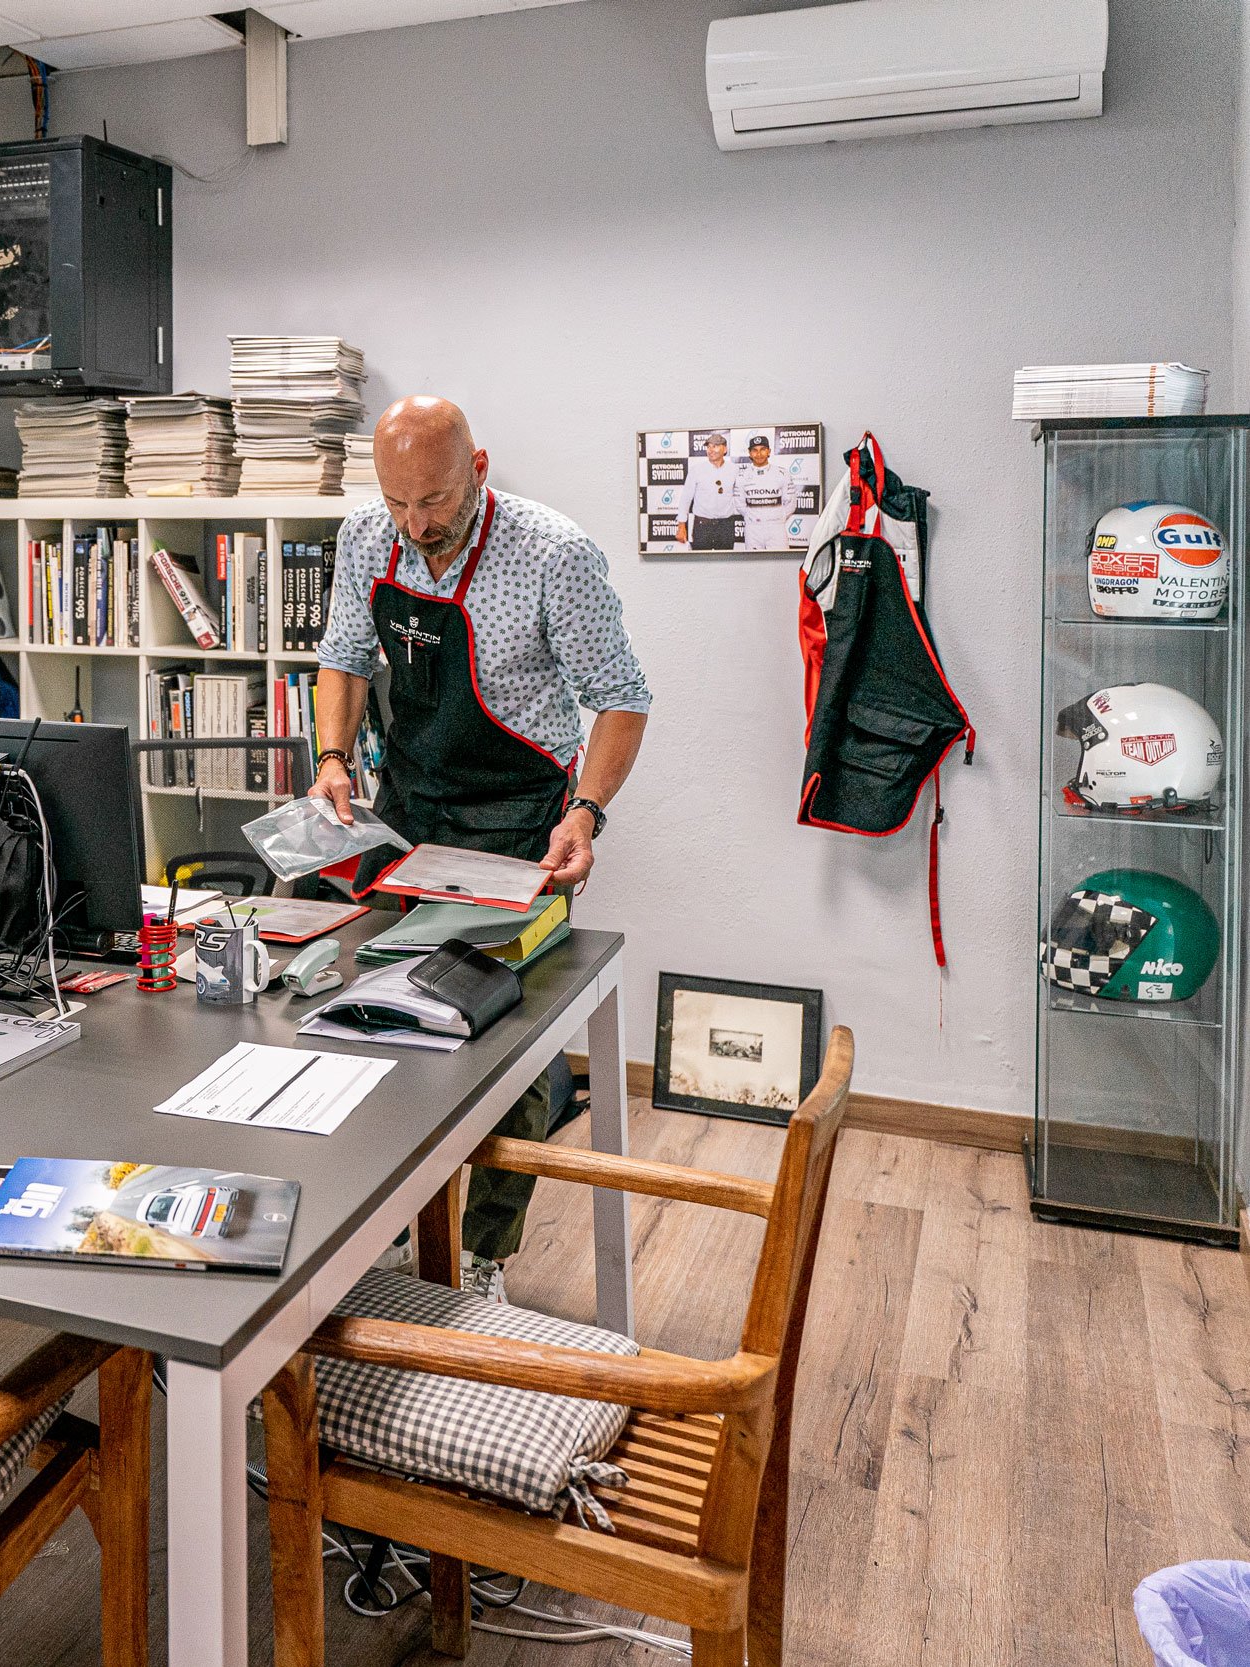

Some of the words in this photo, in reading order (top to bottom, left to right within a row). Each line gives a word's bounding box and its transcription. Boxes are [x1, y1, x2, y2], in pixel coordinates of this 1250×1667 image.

[779, 430, 816, 438] PETRONAS
[779, 437, 816, 448] SYNTIUM
[651, 469, 684, 481] SYNTIUM
[652, 524, 679, 536] SYNTIU
[1096, 534, 1116, 548] OMP
[1157, 528, 1222, 547] Gulf
[1091, 552, 1158, 565] BOXER
[1091, 562, 1157, 574] PASSION
[157, 551, 183, 592] PORSCHE
[178, 589, 192, 607] 911
[1159, 575, 1228, 588] VALENTIN
[1156, 587, 1225, 599] MOTORS
[75, 600, 85, 619] 993
[310, 604, 321, 628] 996
[390, 619, 441, 641] VALENTIN
[1121, 734, 1175, 743] VALENTIN
[1123, 741, 1146, 761] TEAM
[1145, 739, 1175, 763] OUTLAW
[12, 1018, 76, 1036] CIEN
